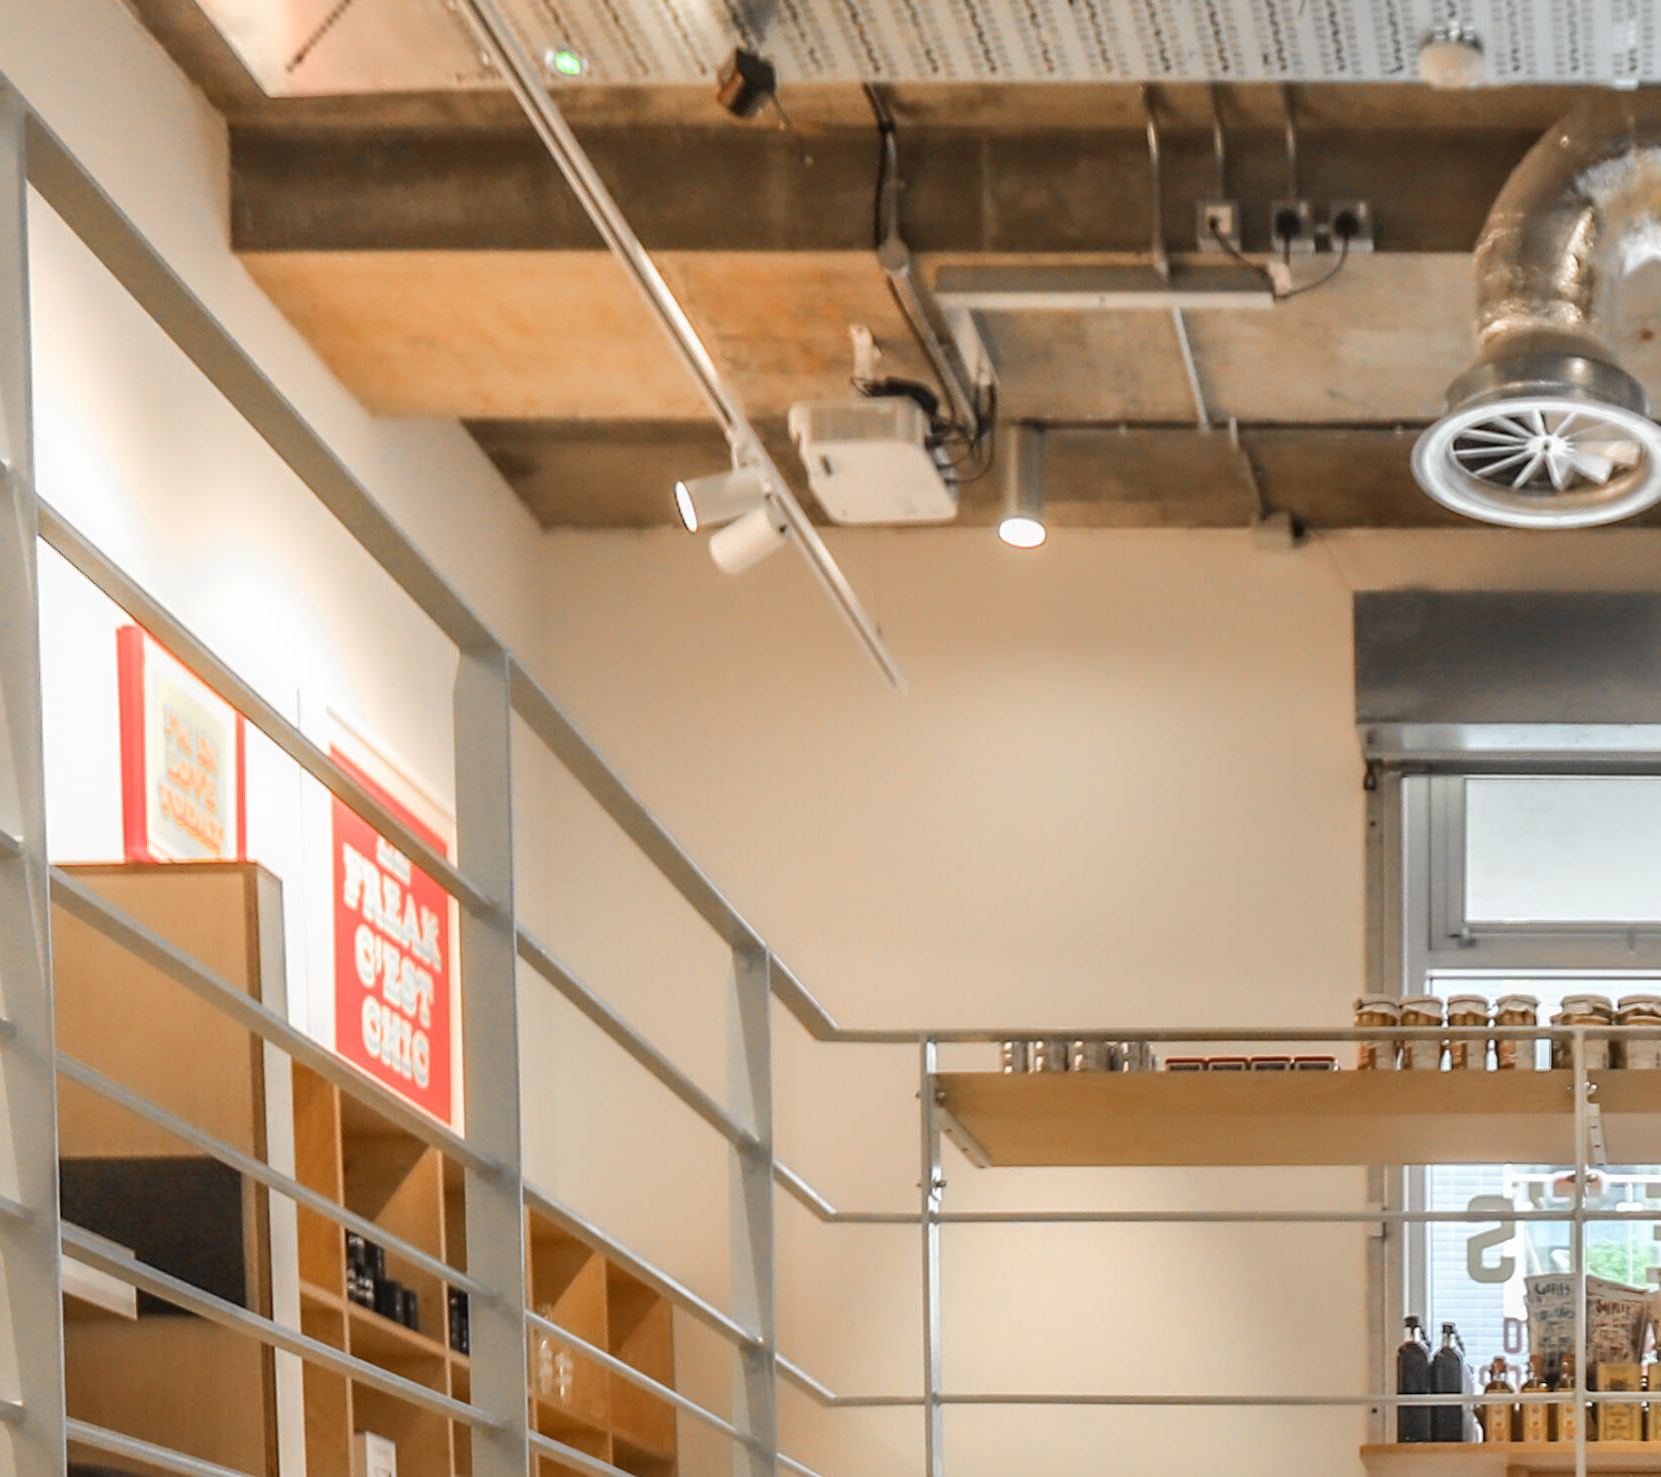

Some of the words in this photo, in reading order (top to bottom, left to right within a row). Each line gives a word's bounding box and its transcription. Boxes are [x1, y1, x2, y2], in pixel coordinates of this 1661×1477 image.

[343, 840, 441, 972] FREAK
[354, 924, 434, 1029] C'EST
[361, 995, 430, 1088] CHIC
